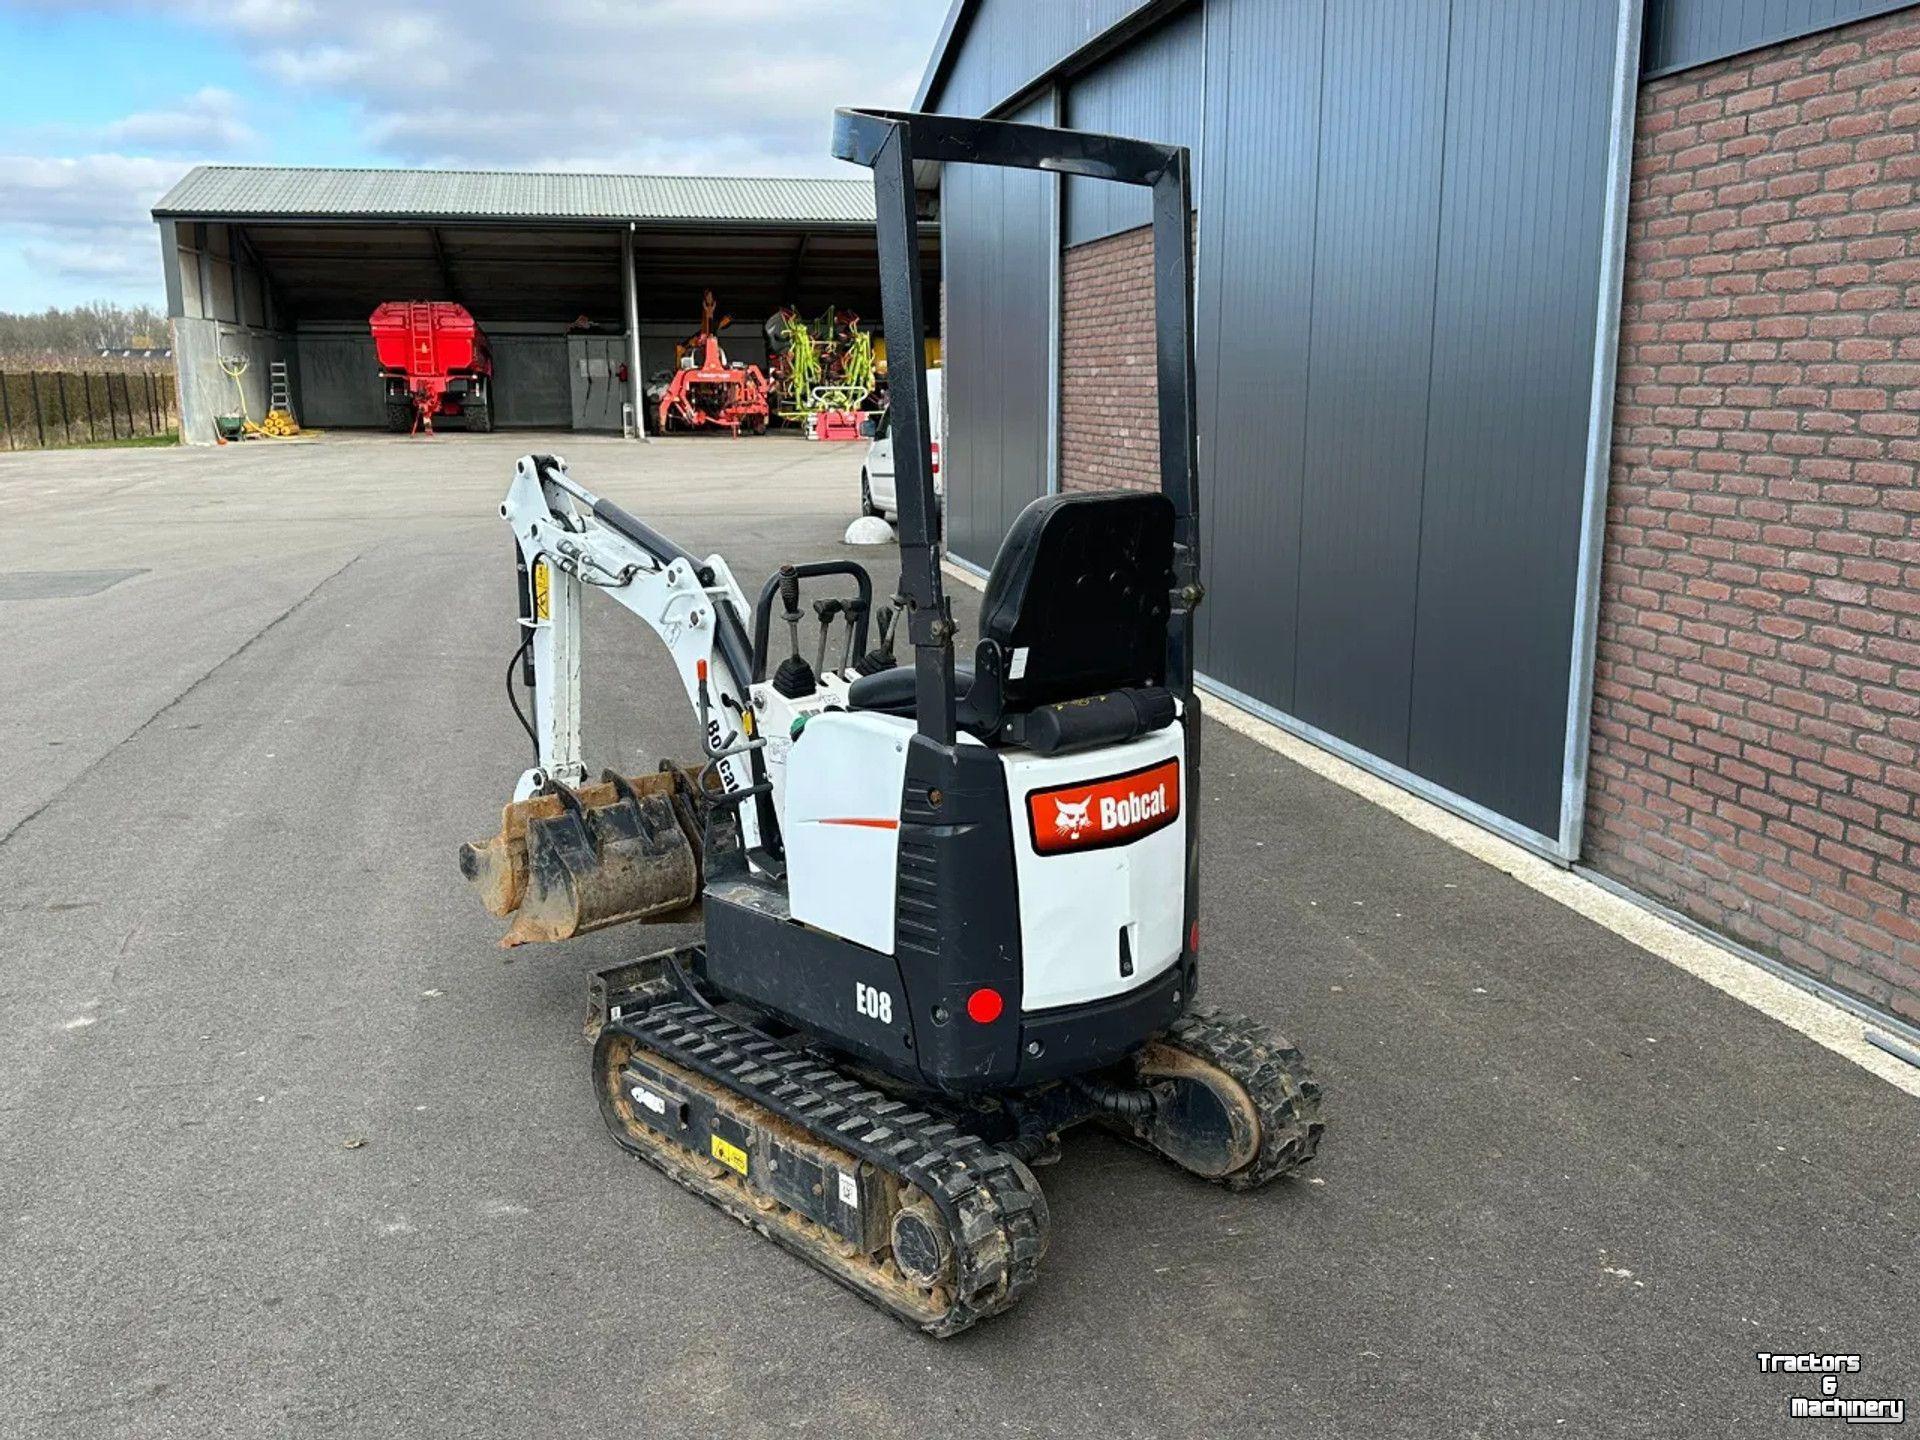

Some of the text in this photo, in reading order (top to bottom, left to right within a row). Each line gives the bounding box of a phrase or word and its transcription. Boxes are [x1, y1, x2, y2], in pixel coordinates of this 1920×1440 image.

[708, 720, 740, 793] Bocat
[1100, 783, 1166, 831] Bobcat
[856, 981, 893, 1025] E08
